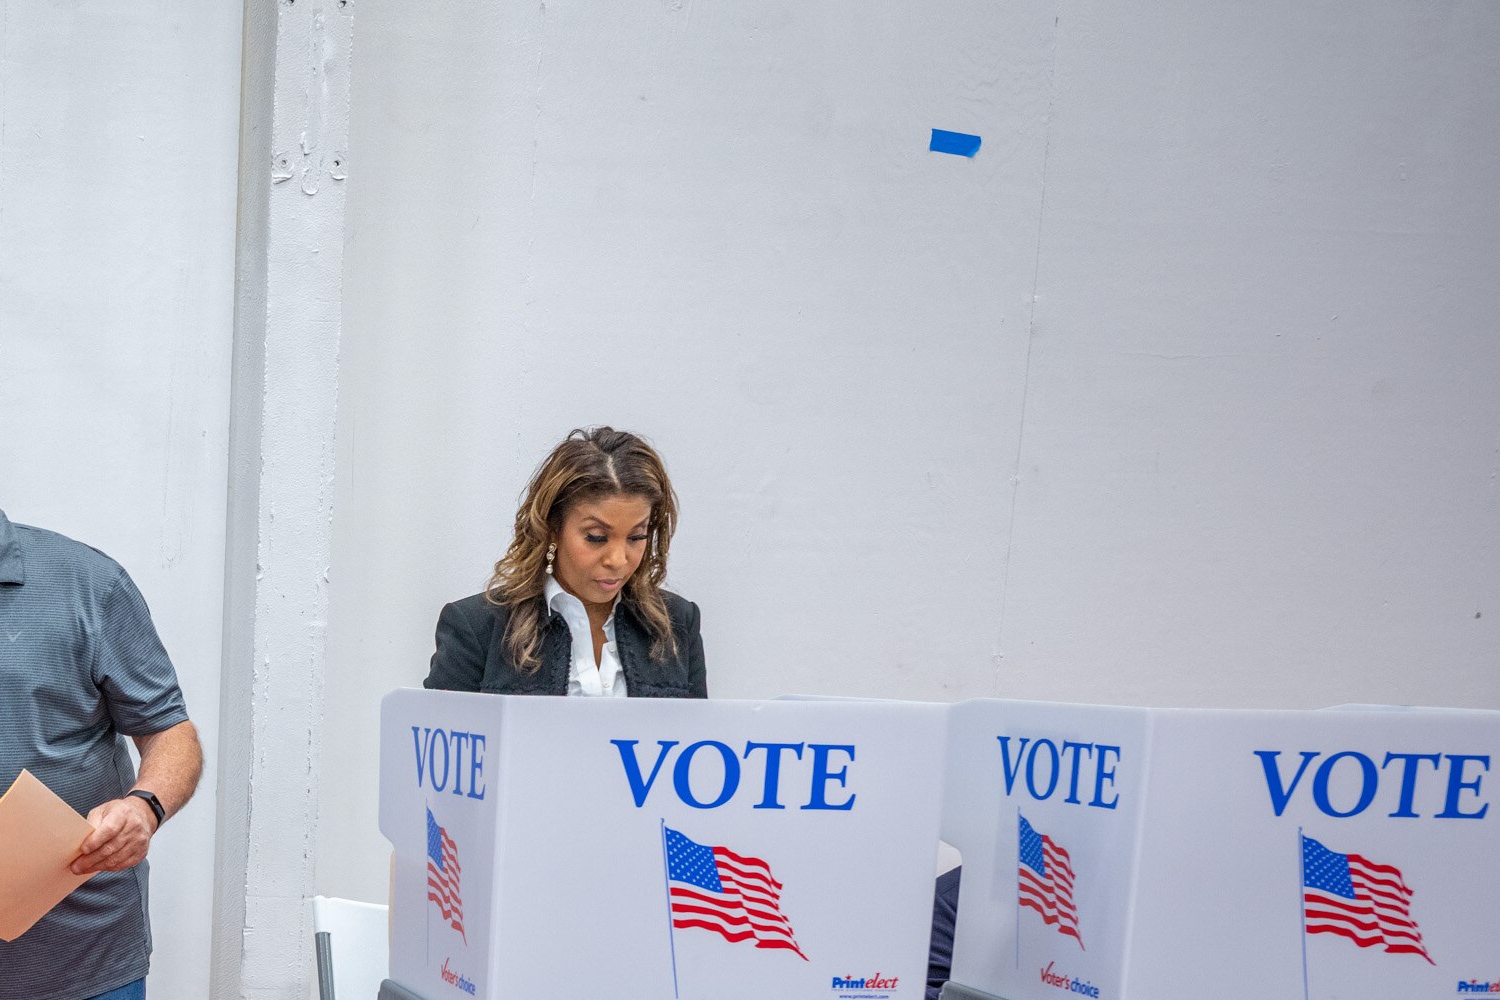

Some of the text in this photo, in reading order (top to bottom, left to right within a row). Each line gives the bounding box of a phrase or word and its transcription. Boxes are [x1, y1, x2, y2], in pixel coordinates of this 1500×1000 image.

[412, 726, 486, 801] VOTE
[610, 739, 857, 811] VOTE
[997, 735, 1121, 810] VOTE
[1253, 750, 1490, 820] VOTE
[440, 957, 476, 996] Voter's choice
[832, 972, 899, 989] Printelect
[1040, 960, 1100, 999] Voter's choice
